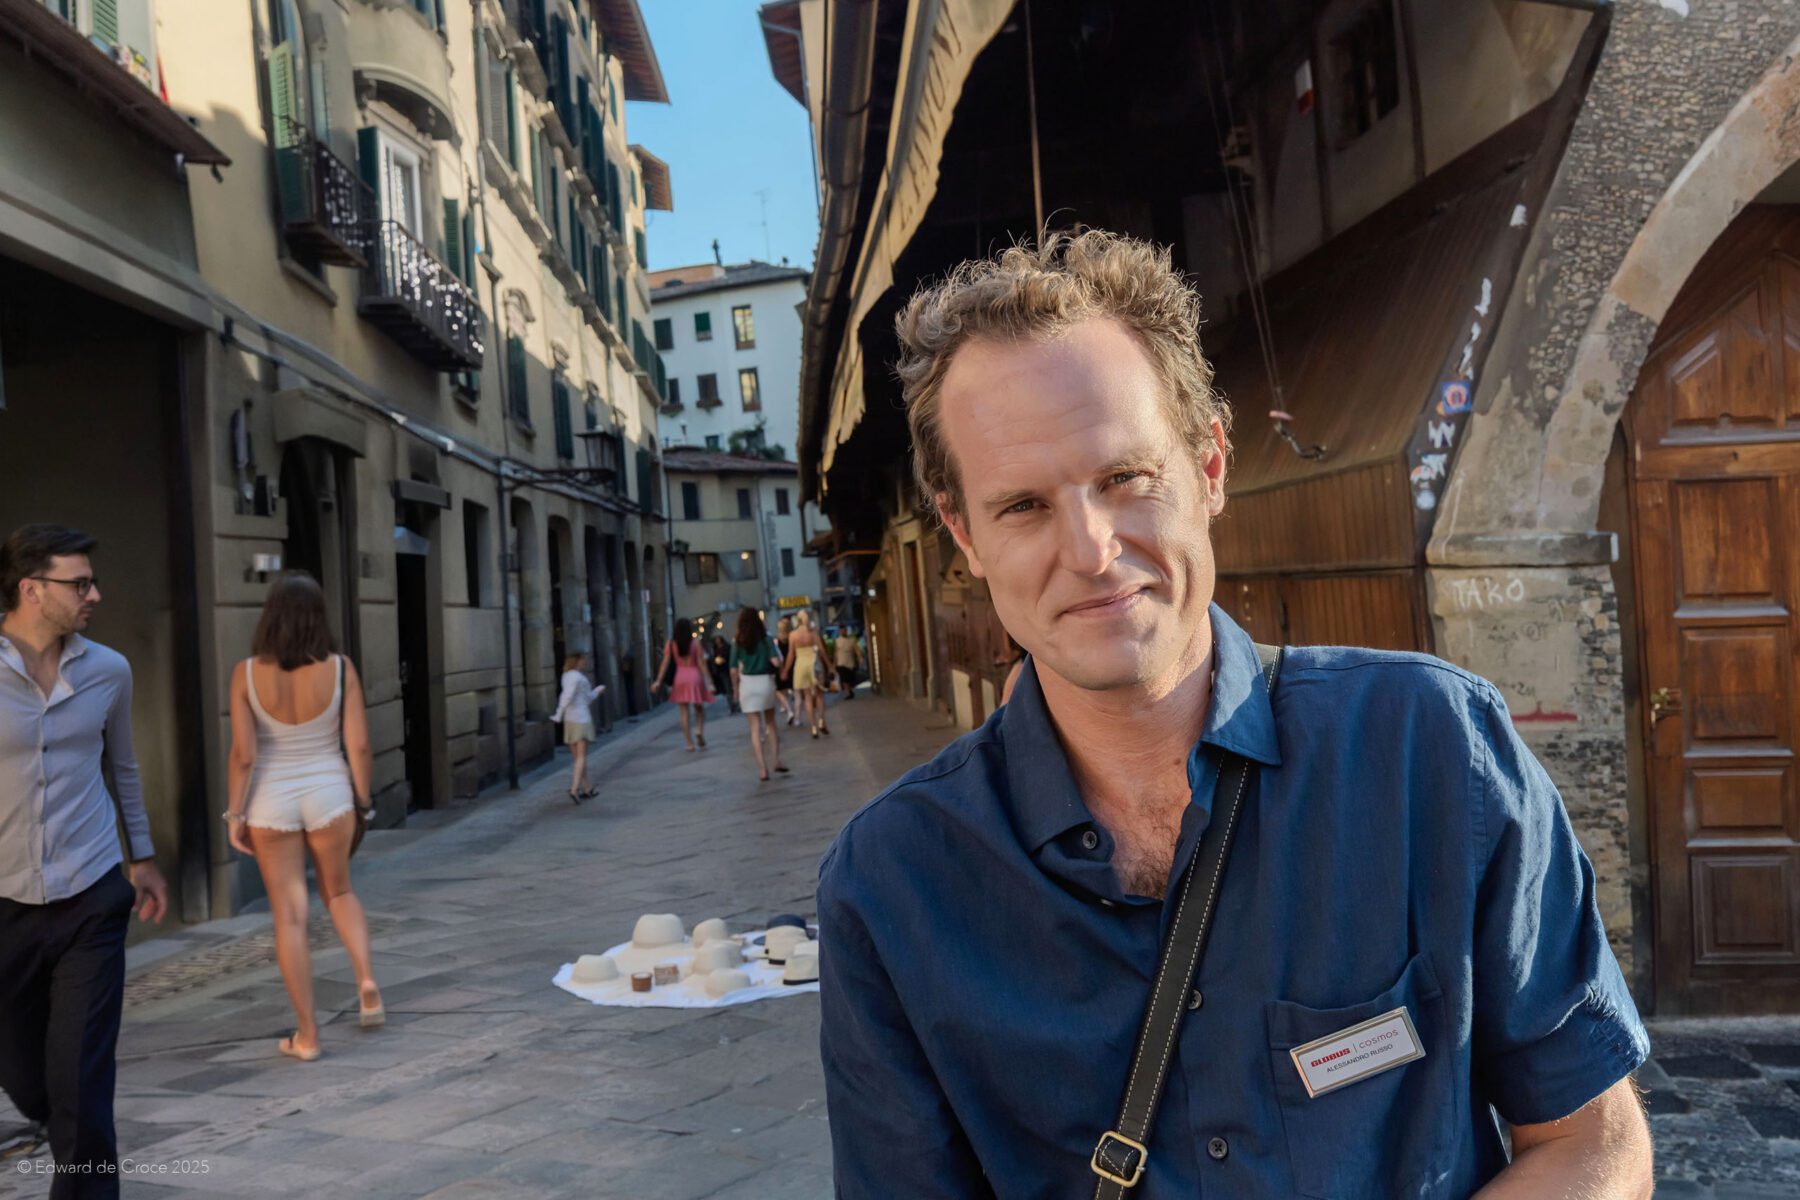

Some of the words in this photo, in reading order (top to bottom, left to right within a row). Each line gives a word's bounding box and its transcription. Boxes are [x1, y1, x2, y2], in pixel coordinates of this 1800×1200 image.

[1451, 577, 1525, 609] TAKO
[1310, 1048, 1351, 1068] GLOBUS
[1359, 1029, 1399, 1049] cosmos
[1326, 1052, 1370, 1073] ALESSANDRO
[1370, 1043, 1394, 1057] RUSSO
